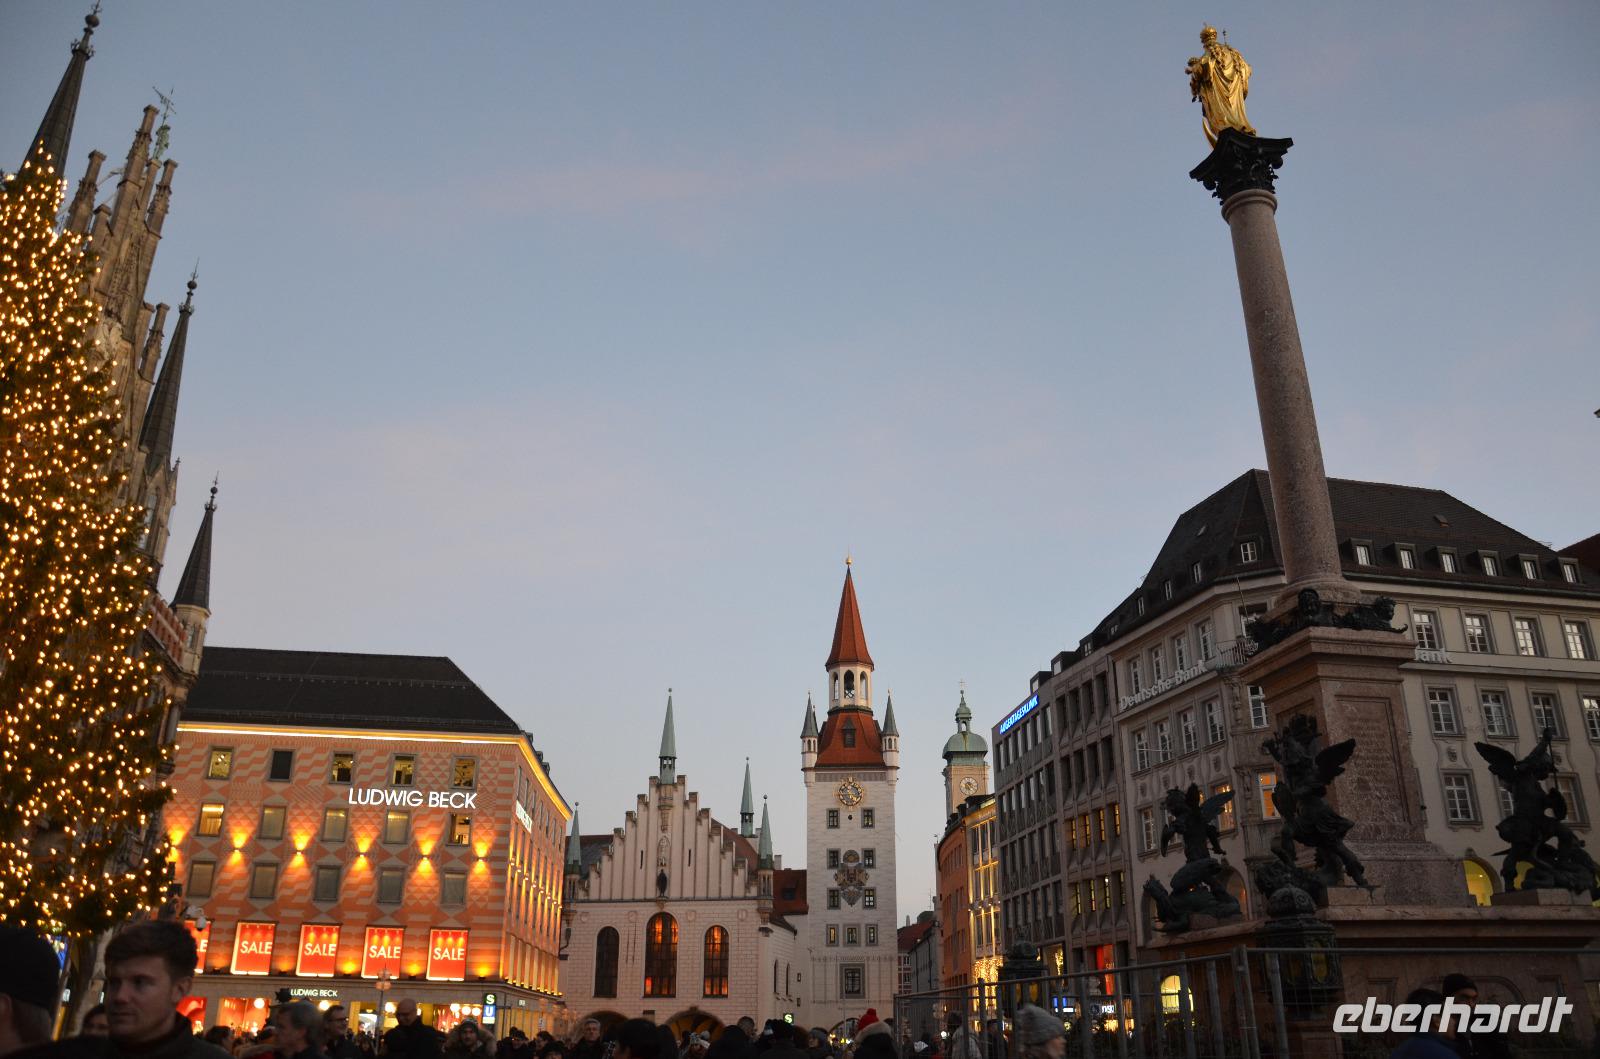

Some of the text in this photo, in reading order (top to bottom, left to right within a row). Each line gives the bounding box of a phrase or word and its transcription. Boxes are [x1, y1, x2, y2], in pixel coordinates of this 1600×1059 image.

[1414, 647, 1454, 664] ank
[1119, 660, 1208, 709] Deutsche Bank
[348, 787, 477, 809] LUDWIG BECK
[240, 941, 273, 955] SALE
[304, 943, 337, 957] SALE
[368, 945, 401, 959] SALE
[433, 947, 465, 961] SALE
[290, 988, 338, 998] LUDWIG BECK
[486, 994, 495, 1005] S
[485, 1006, 494, 1017] U
[784, 1014, 793, 1023] S
